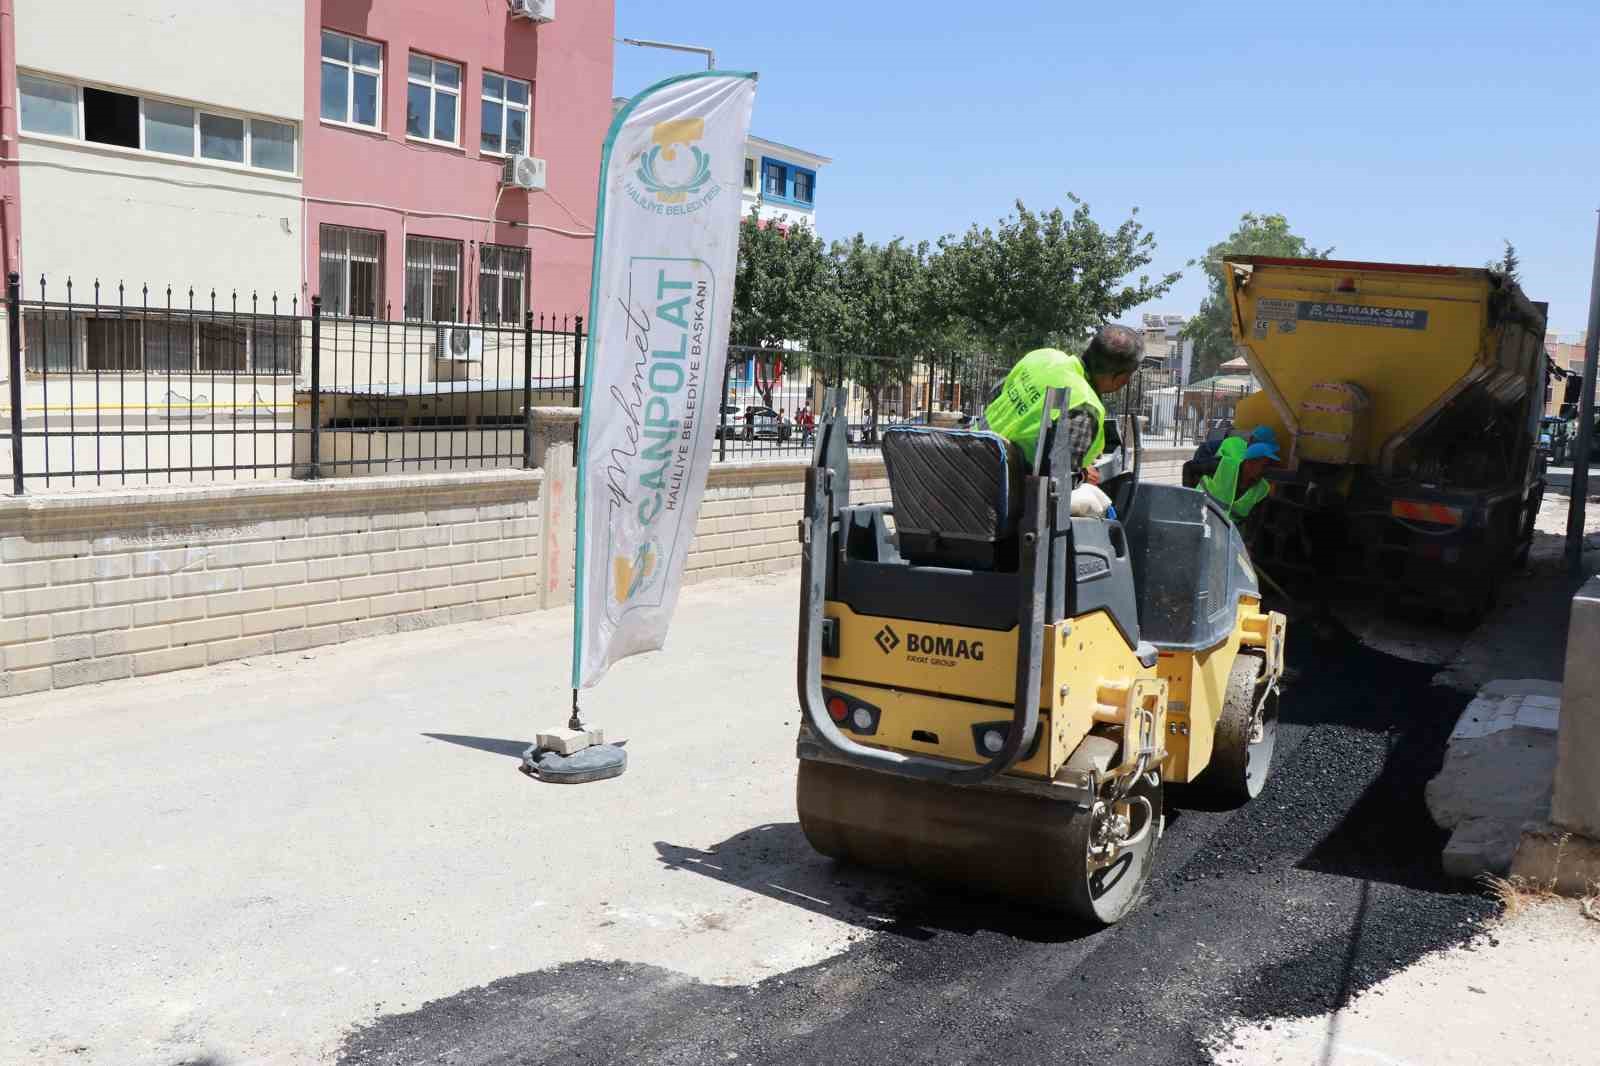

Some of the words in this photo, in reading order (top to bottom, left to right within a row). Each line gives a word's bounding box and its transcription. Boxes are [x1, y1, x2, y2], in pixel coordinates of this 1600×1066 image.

[692, 280, 707, 356] BAŞKANI
[638, 269, 693, 525] CANPOLAT
[907, 633, 983, 661] BOMAG
